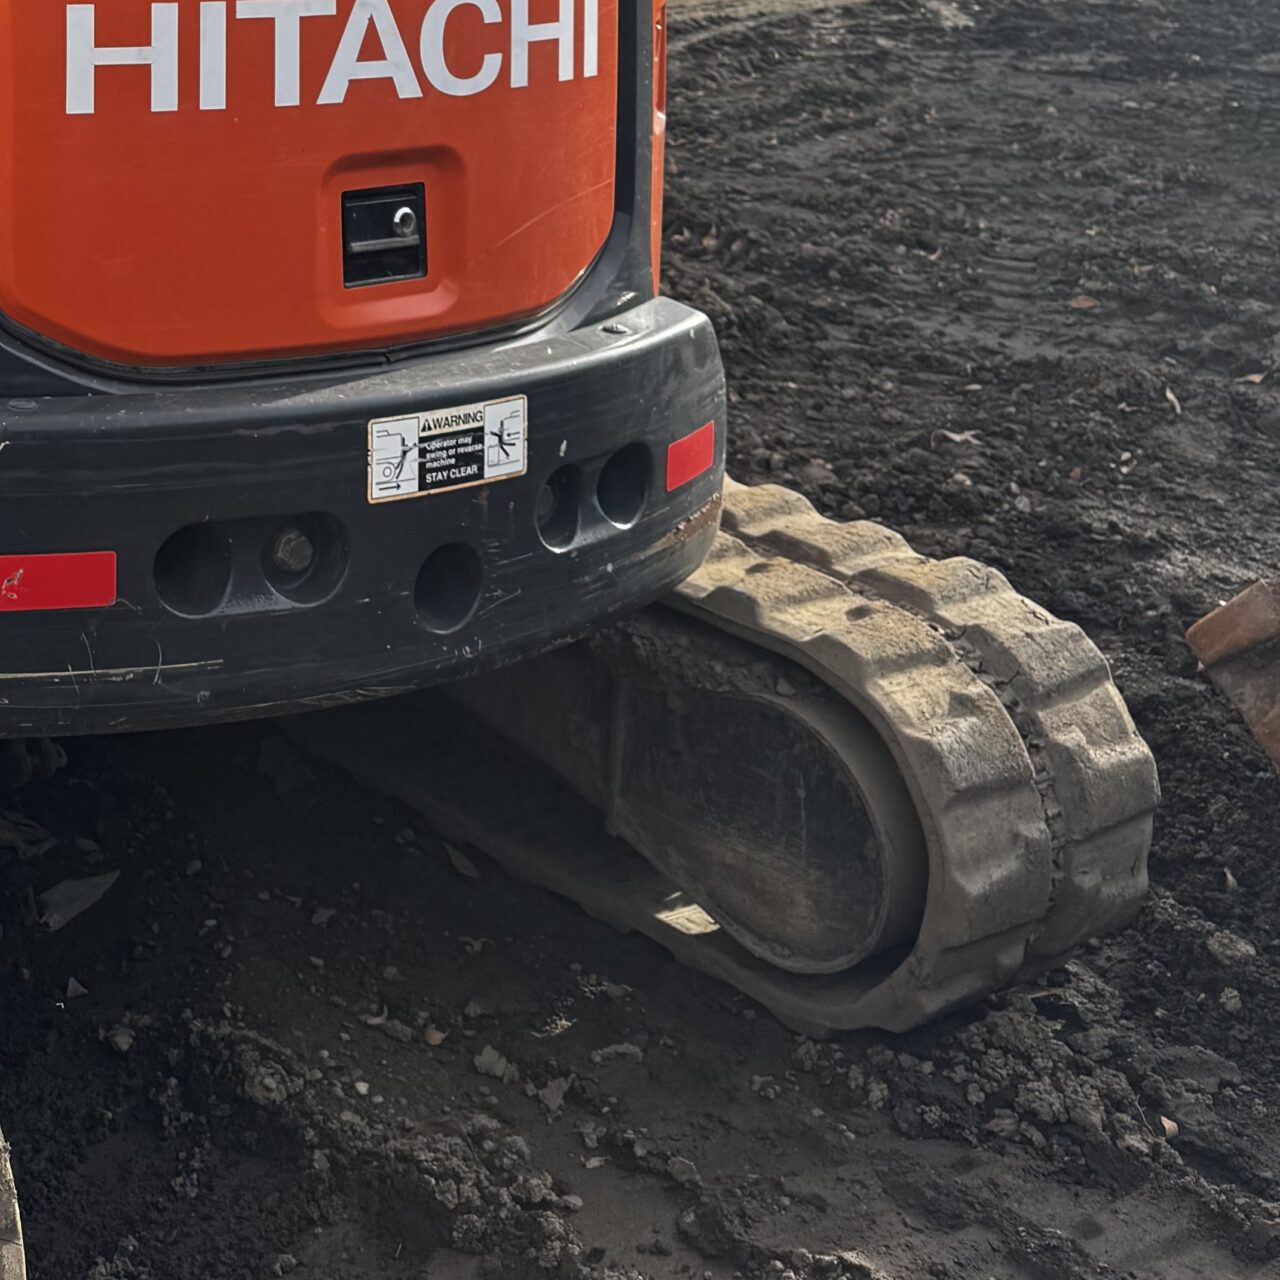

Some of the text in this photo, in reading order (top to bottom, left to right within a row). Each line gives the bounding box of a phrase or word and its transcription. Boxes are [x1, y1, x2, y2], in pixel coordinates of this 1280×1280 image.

[432, 410, 483, 429] WARNING
[425, 436, 473, 451] Operator may
[426, 443, 483, 460] swing or reverse
[425, 457, 456, 469] machine
[425, 464, 479, 483] STAY CLEAR
